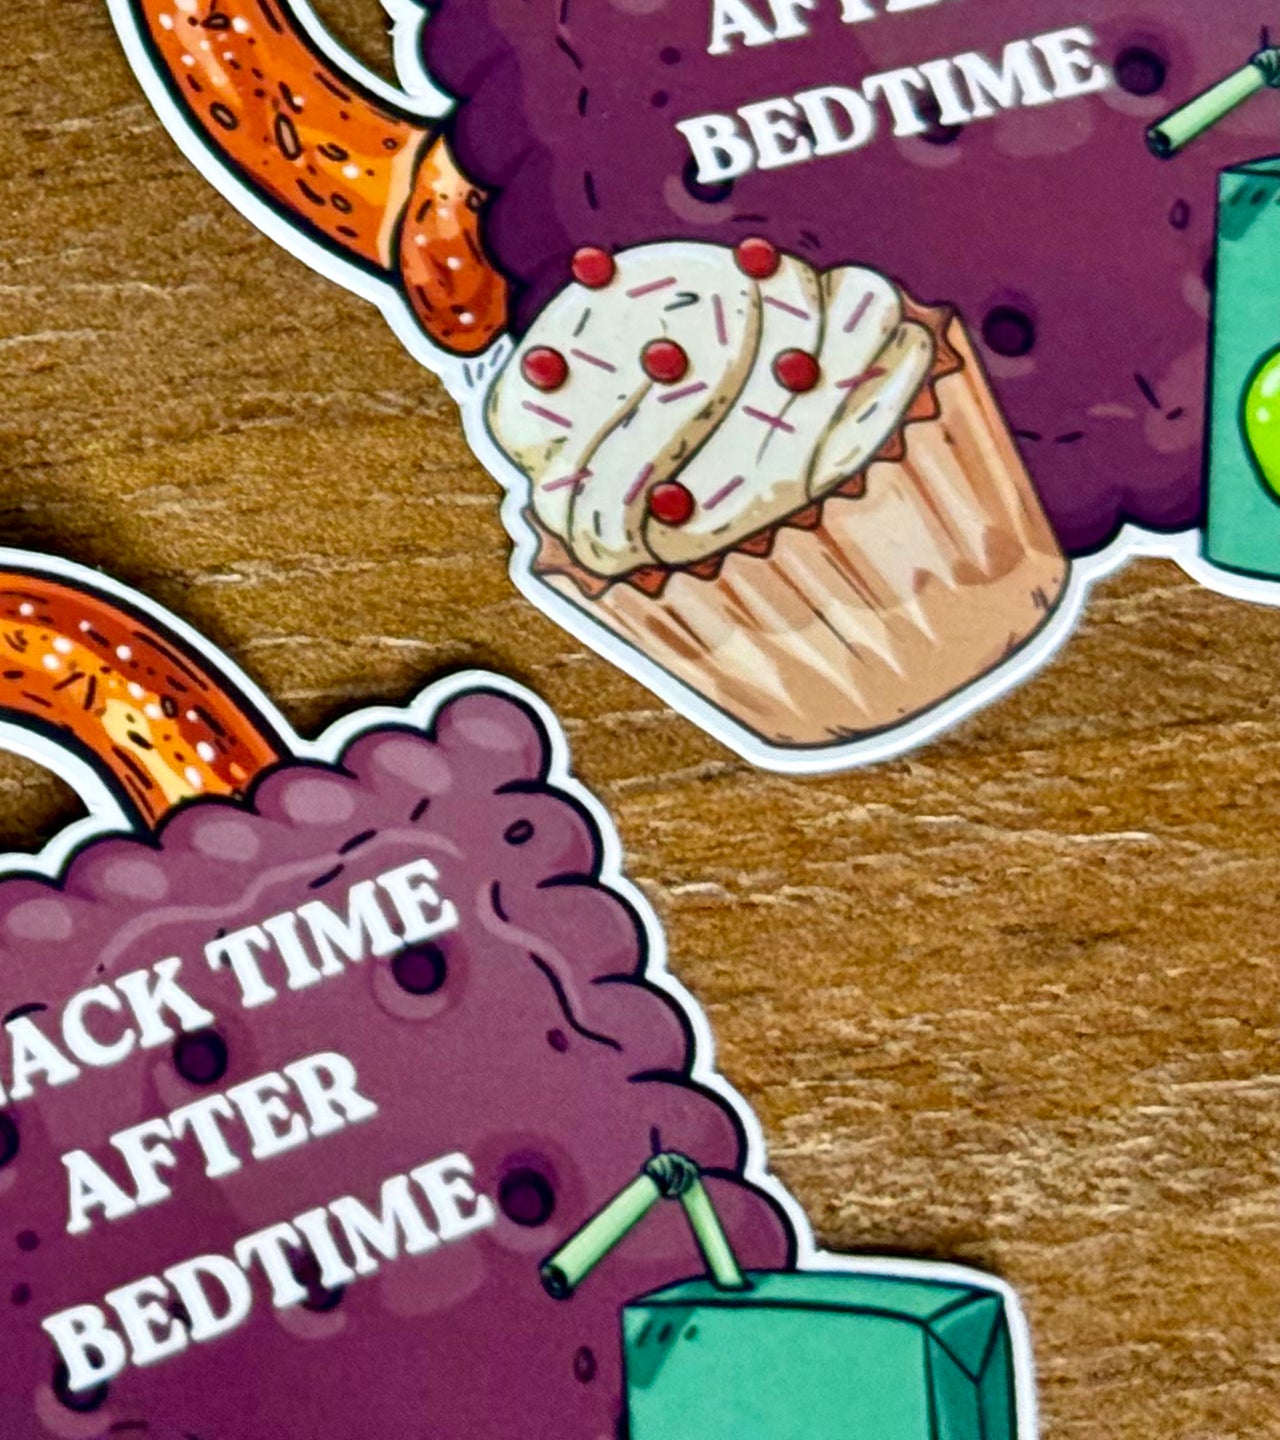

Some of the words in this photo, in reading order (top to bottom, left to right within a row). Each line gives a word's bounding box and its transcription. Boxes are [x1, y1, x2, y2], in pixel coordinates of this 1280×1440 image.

[674, 24, 1116, 185] BEDTIME
[202, 856, 462, 1010] TIME
[59, 1050, 380, 1236] AFTER
[40, 1150, 498, 1393] BEDTIME
